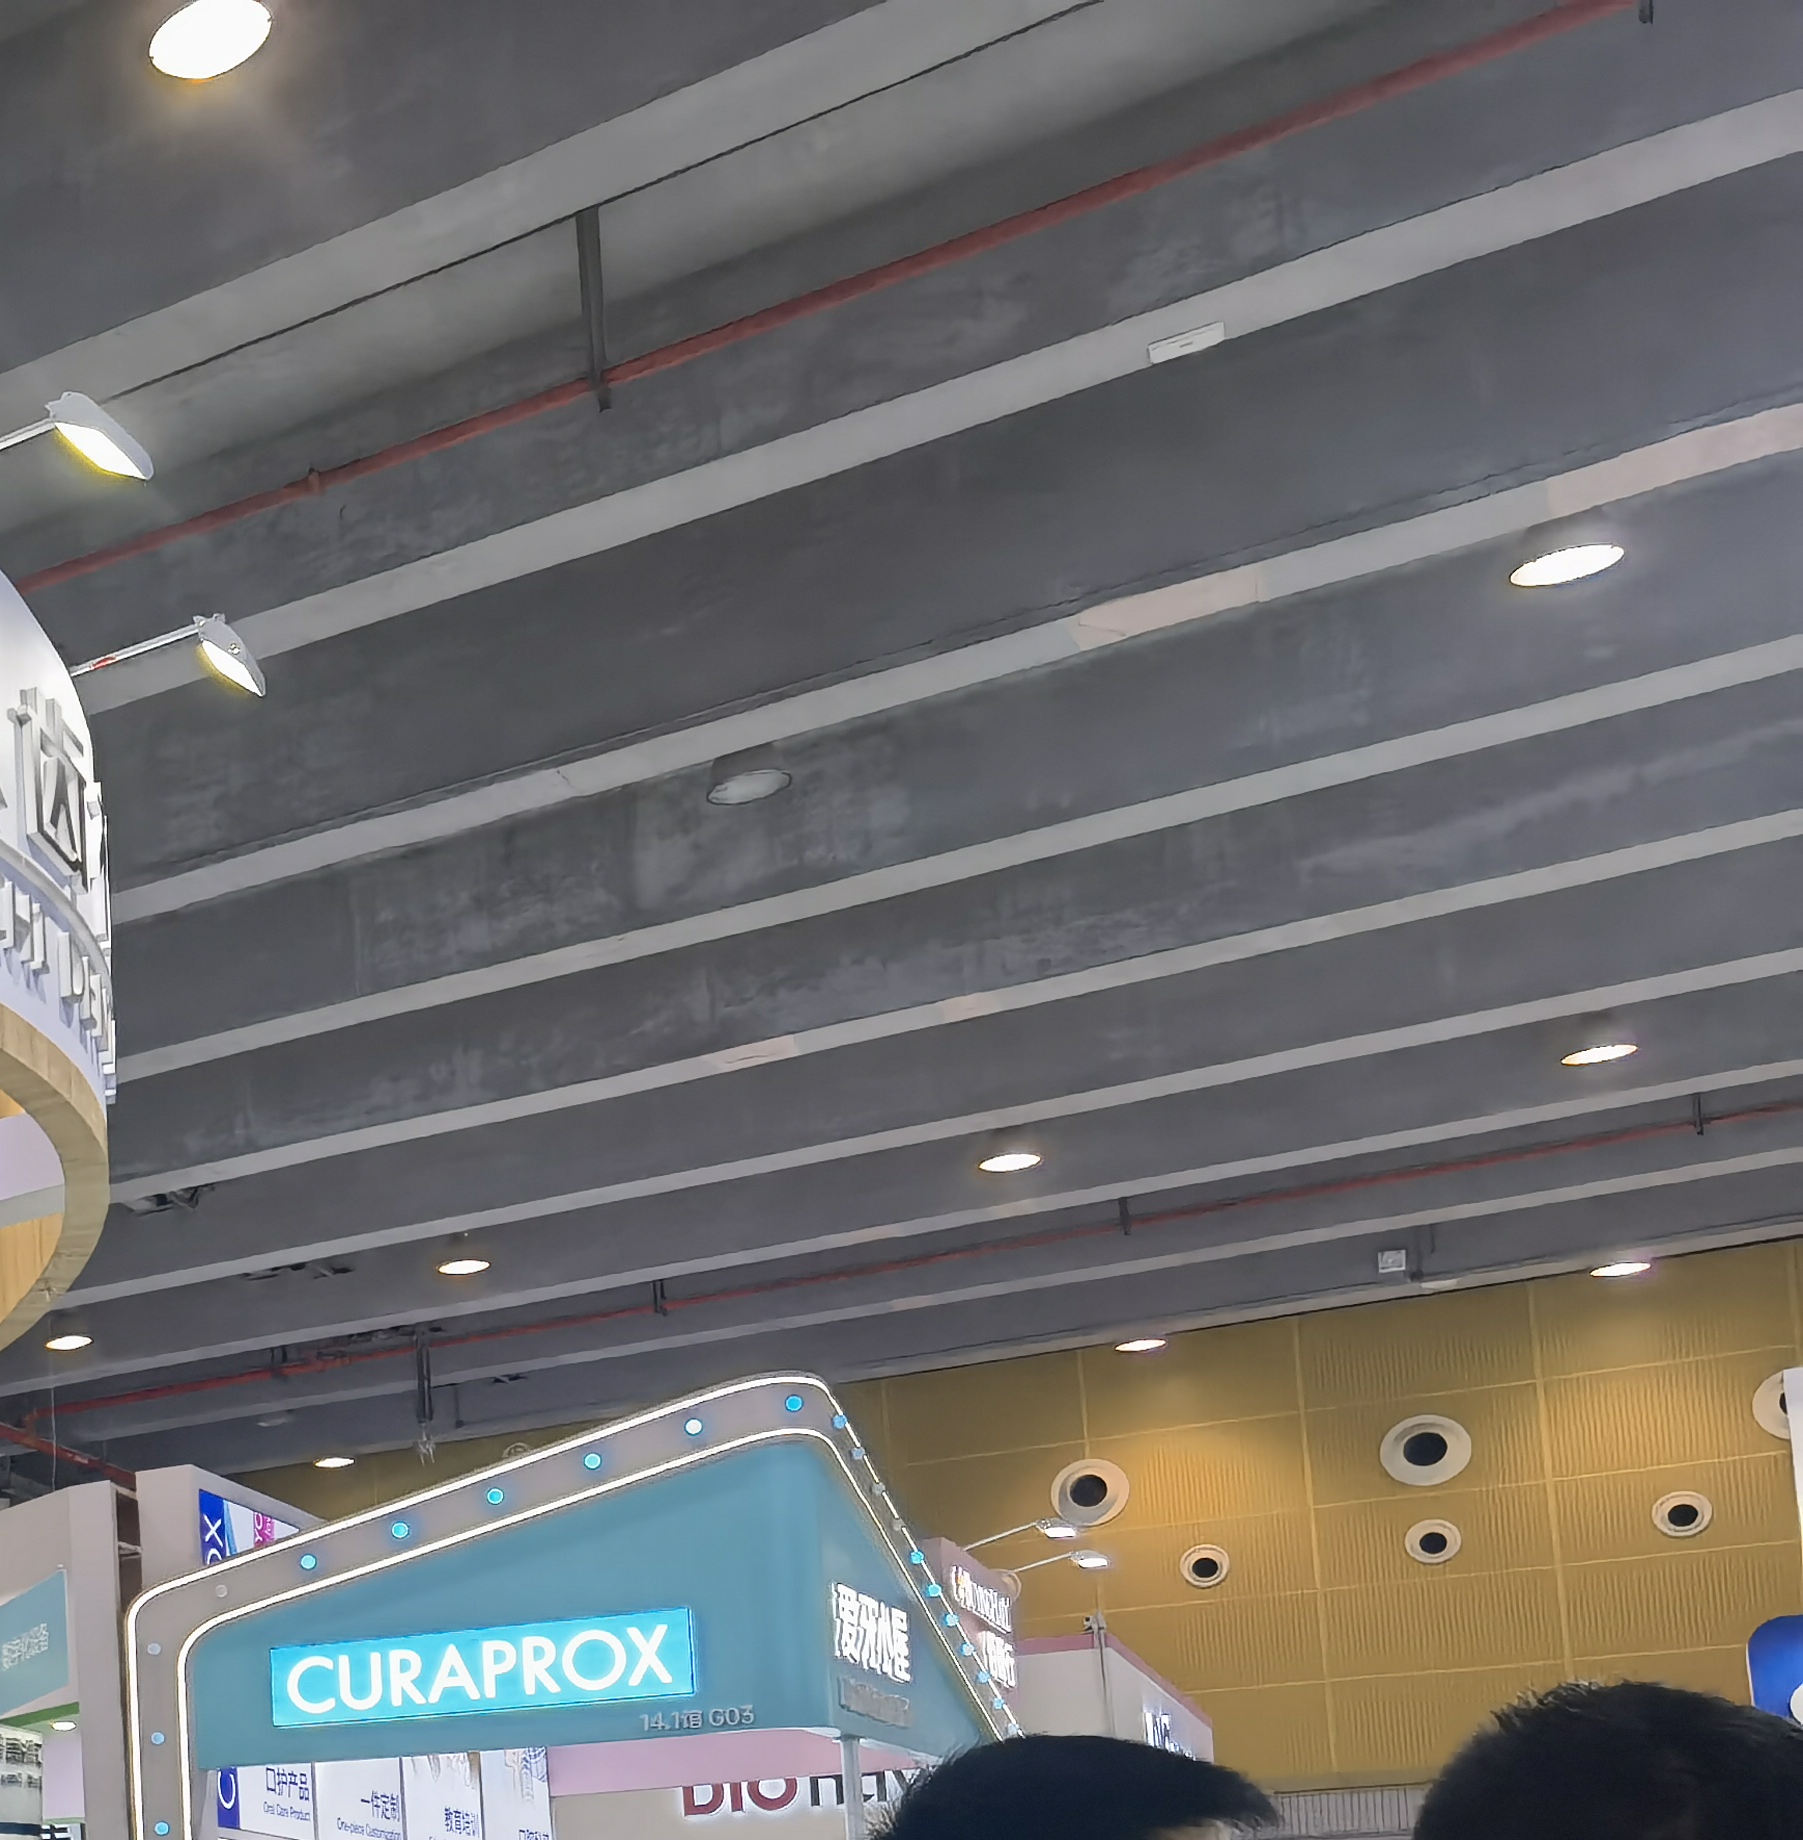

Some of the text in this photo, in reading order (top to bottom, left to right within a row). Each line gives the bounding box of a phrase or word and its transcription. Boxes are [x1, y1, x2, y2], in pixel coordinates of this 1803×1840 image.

[285, 1622, 674, 1716] CURAPROX
[265, 1766, 310, 1802] 口护产品
[360, 1790, 401, 1823] 一件定制
